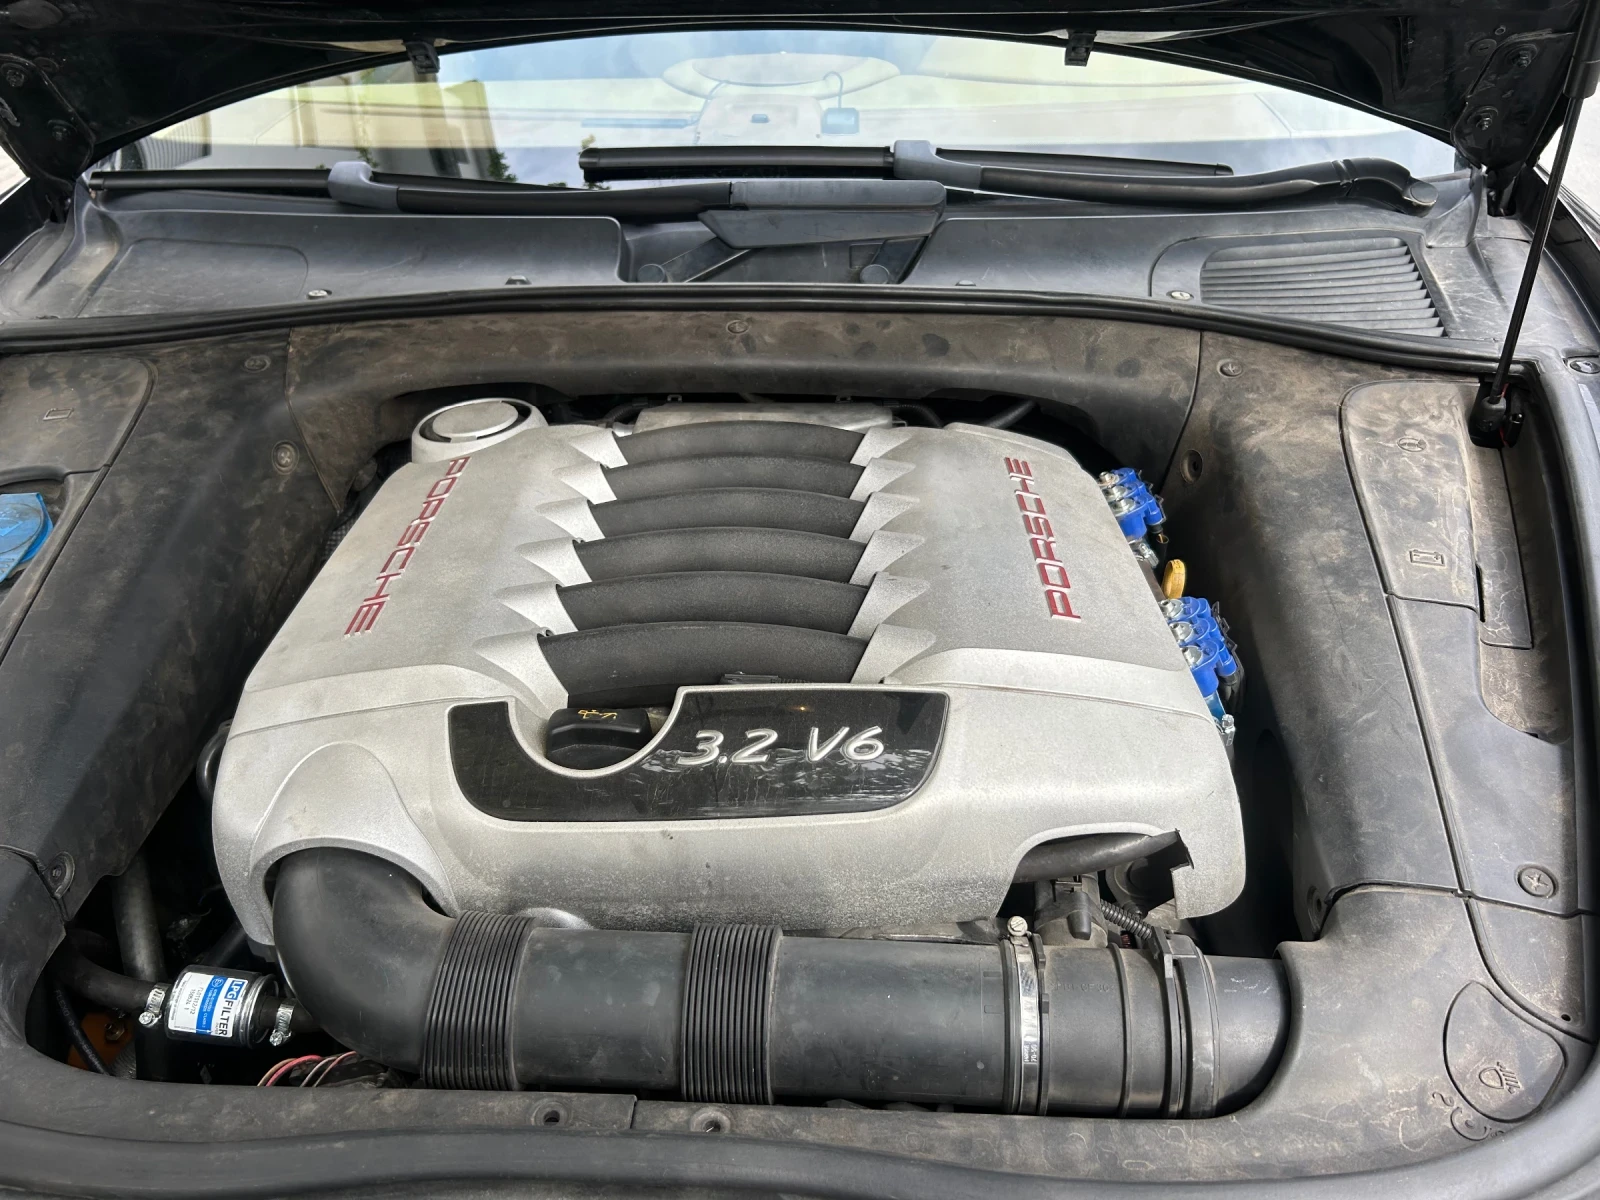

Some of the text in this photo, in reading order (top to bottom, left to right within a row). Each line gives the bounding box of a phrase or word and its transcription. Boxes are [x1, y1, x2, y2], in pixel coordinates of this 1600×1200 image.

[344, 456, 471, 638] PORSCHE
[1004, 457, 1081, 621] PORSCHE
[677, 726, 884, 764] 3.2 V6
[219, 981, 243, 1036] LPG FILTER
